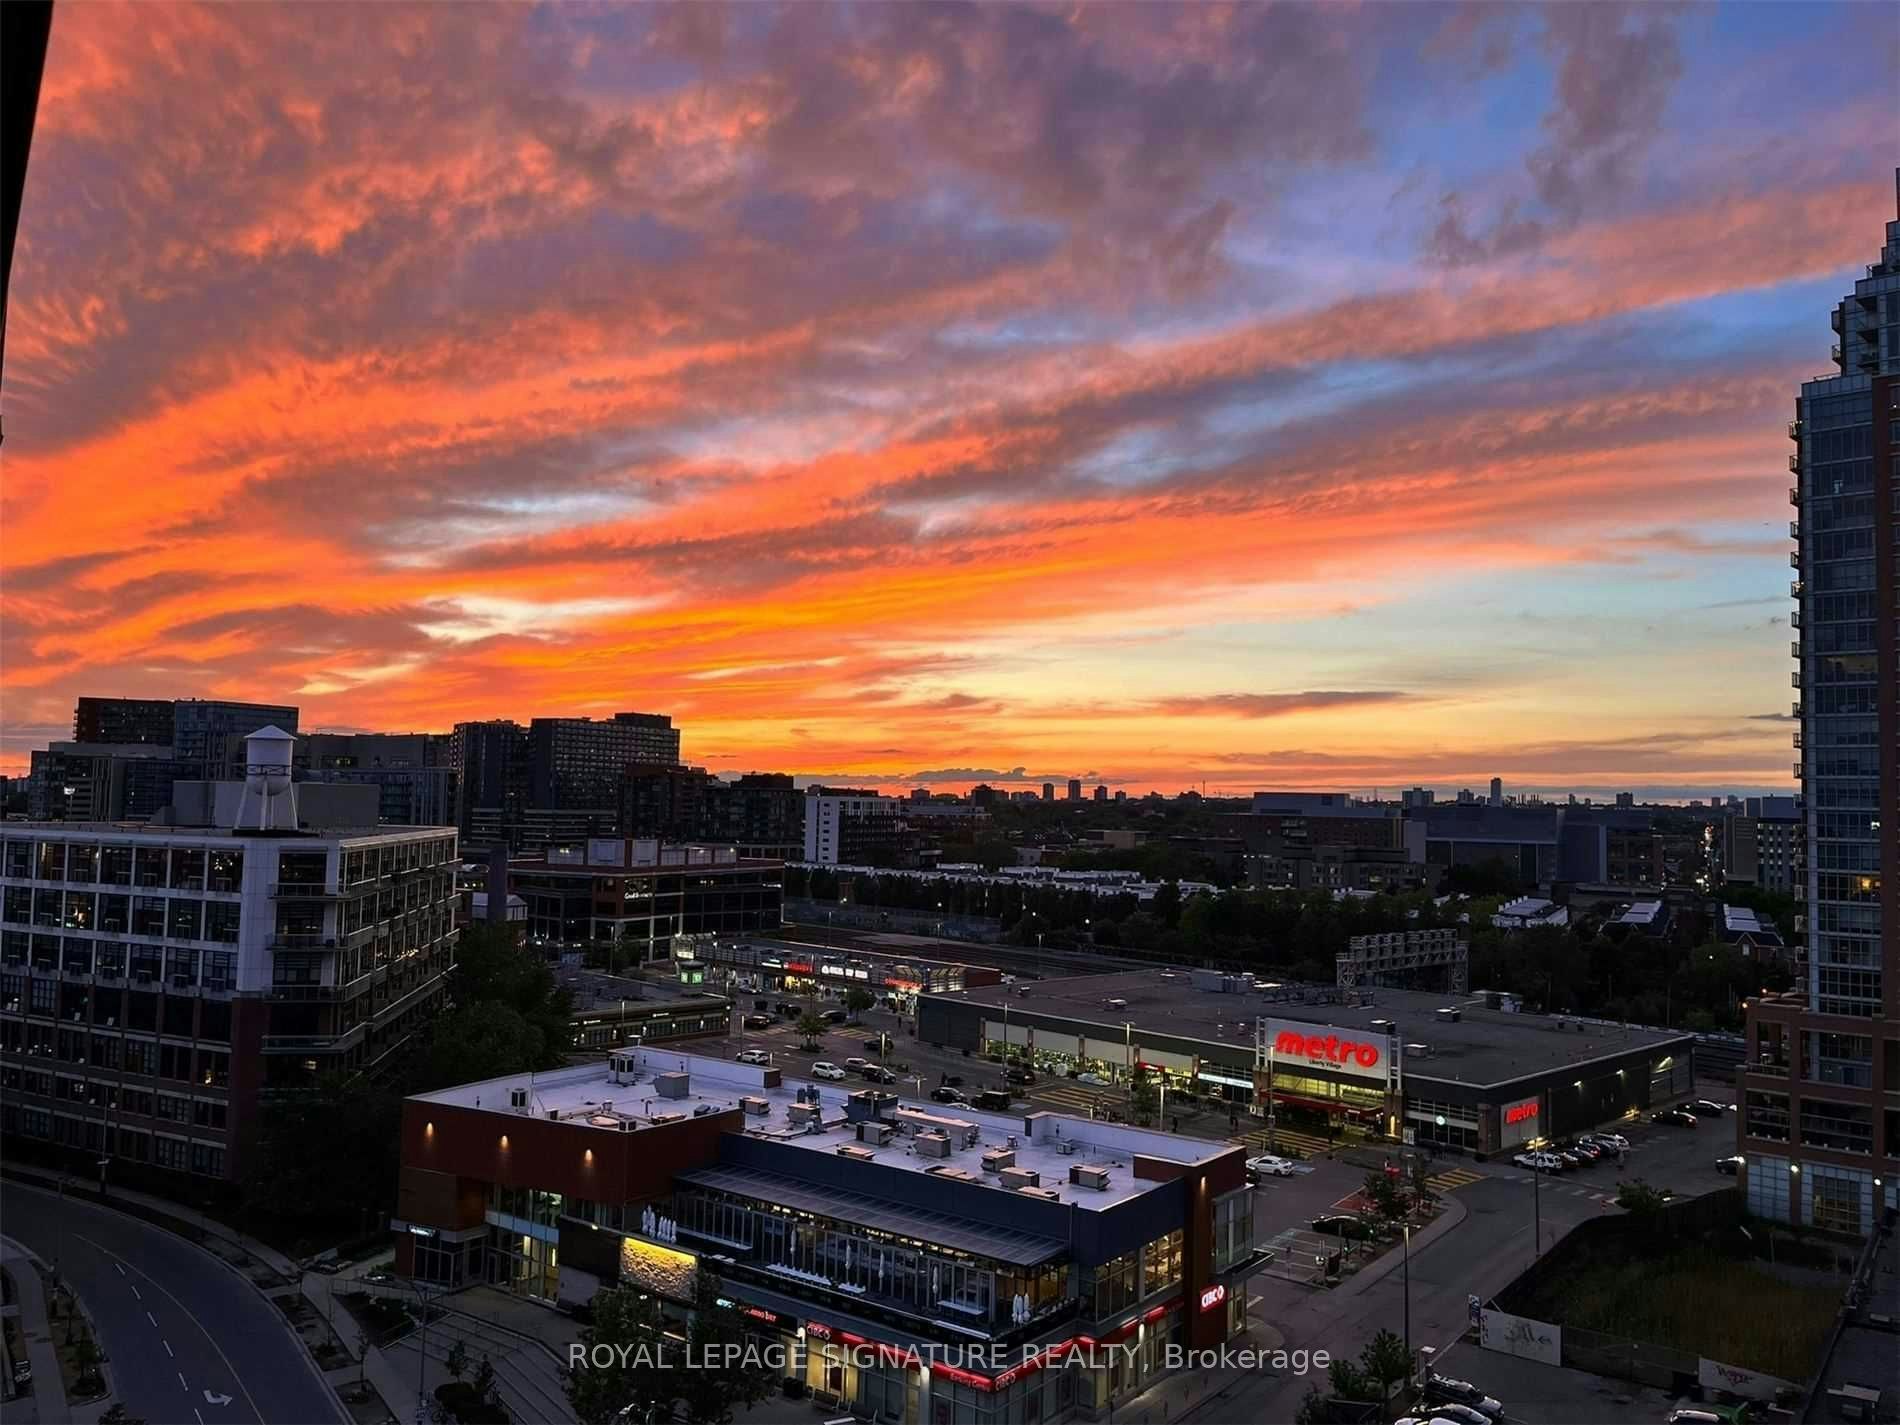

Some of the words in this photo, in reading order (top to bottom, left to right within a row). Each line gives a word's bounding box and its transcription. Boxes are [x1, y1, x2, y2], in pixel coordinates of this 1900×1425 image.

[1276, 1031, 1378, 1067] metro
[1505, 1103, 1539, 1123] metro
[806, 1324, 824, 1338] CIBC
